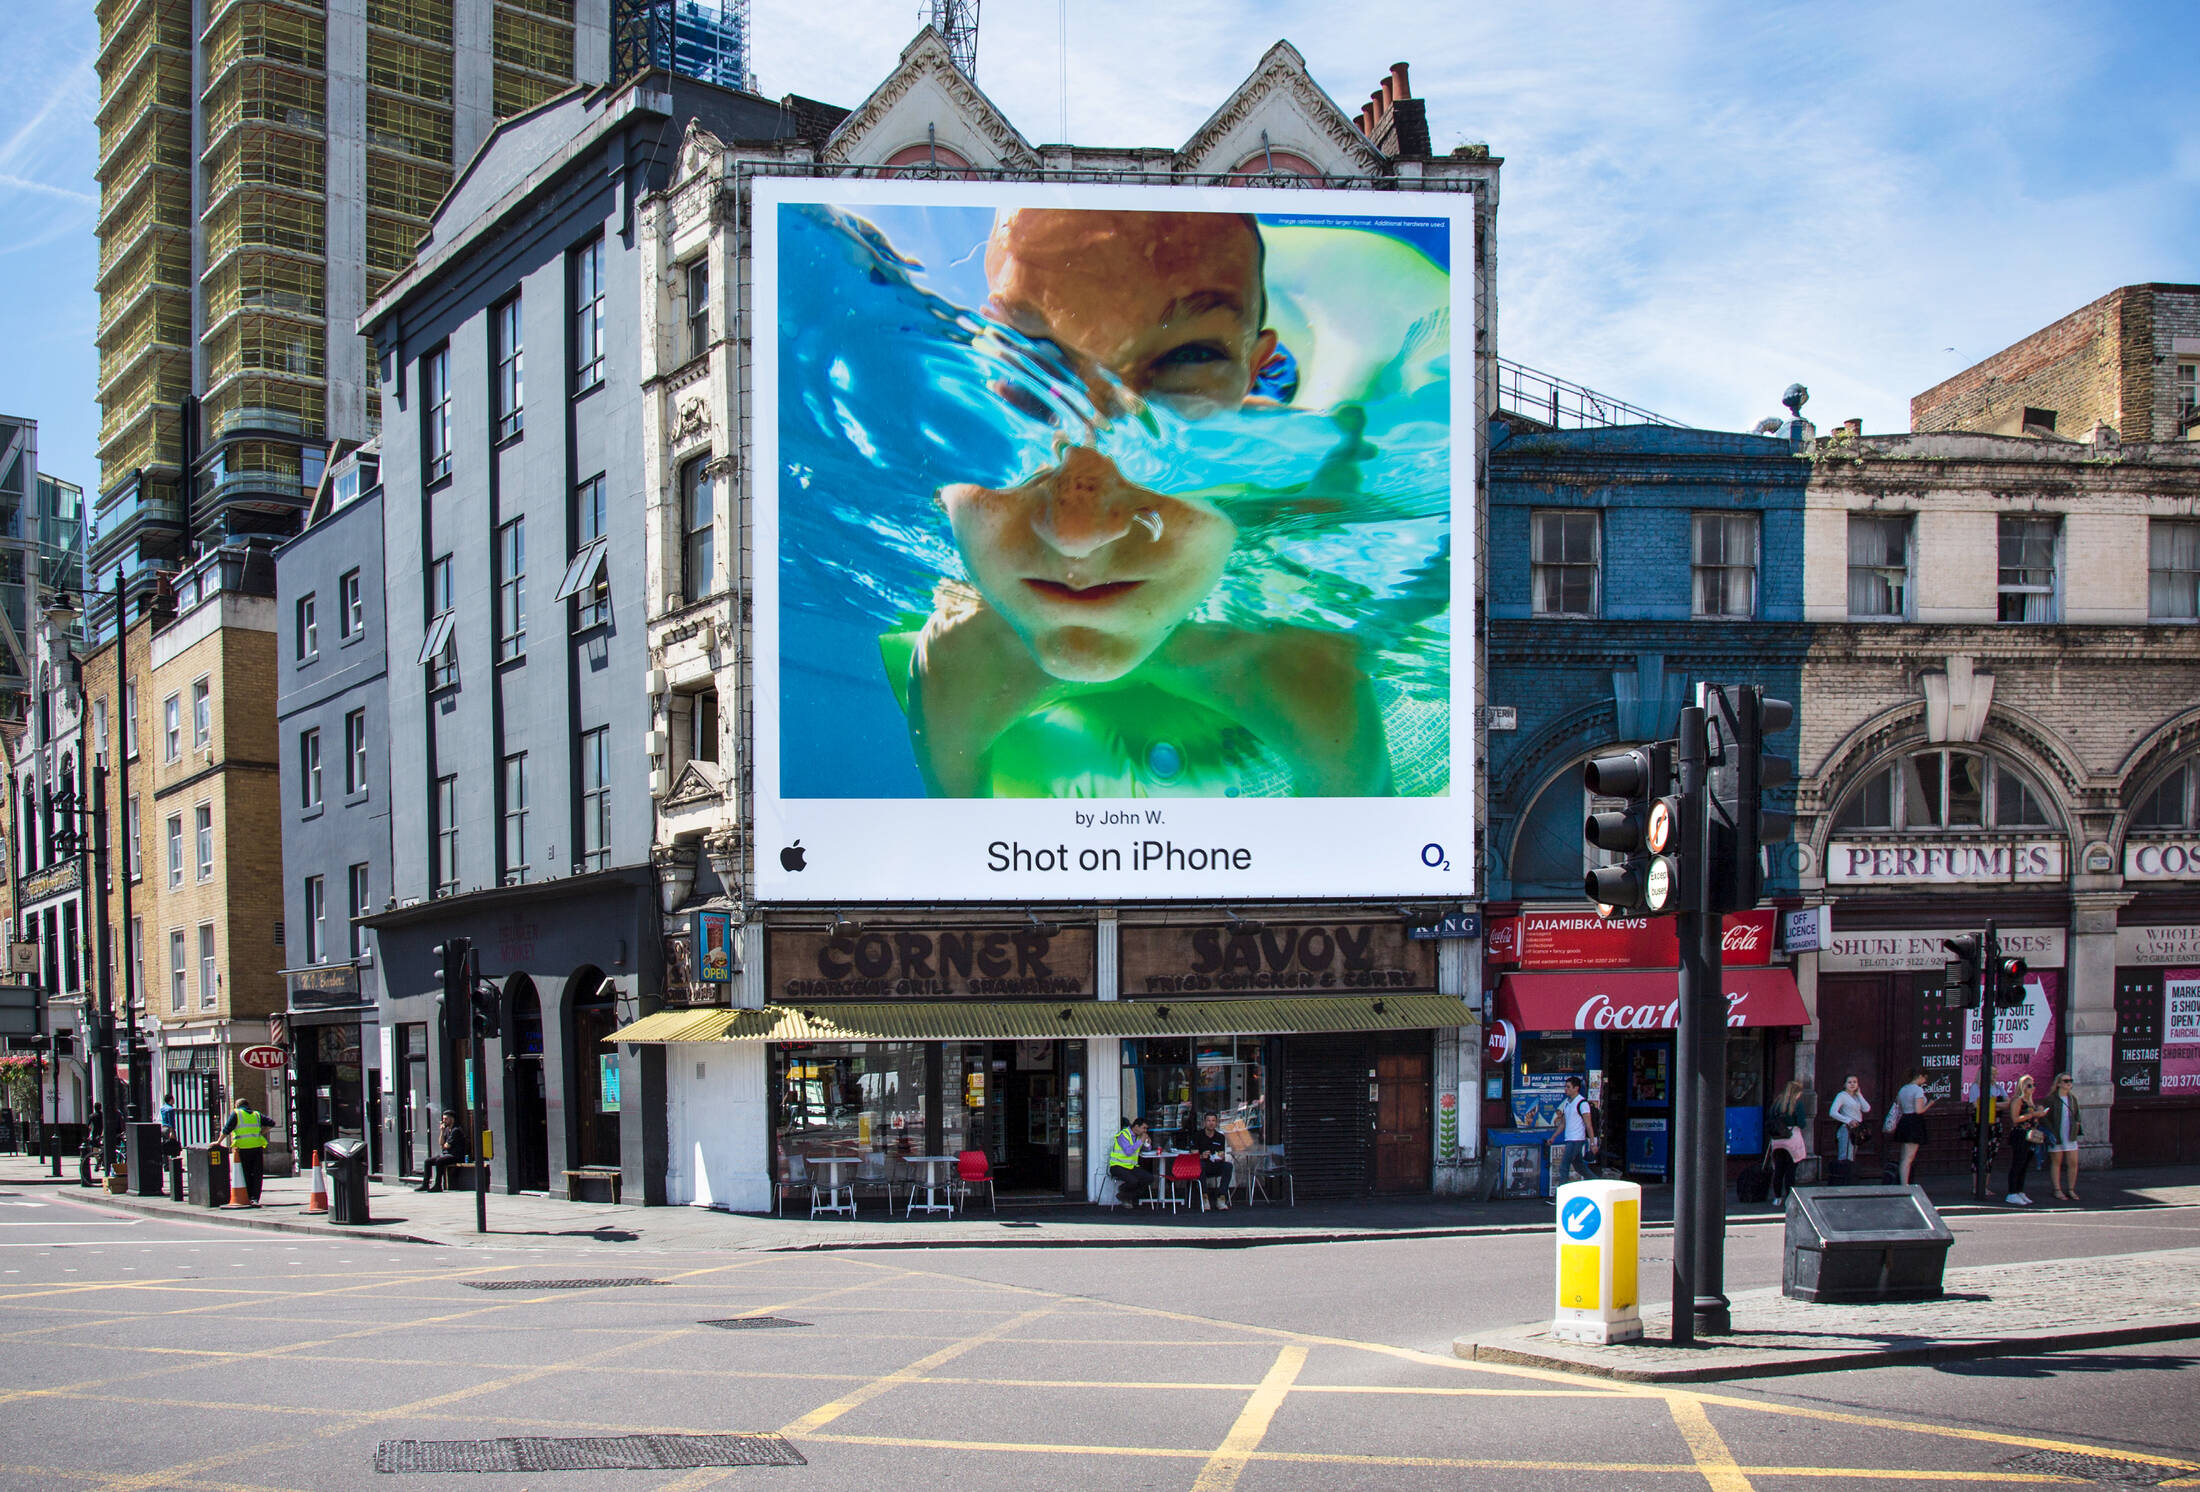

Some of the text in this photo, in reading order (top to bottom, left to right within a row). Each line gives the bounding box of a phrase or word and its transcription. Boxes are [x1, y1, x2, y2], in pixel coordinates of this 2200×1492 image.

[1075, 810, 1166, 828] by John W.
[988, 841, 1252, 872] Shot on iPhone
[1846, 846, 2049, 876] PERFUMES
[1527, 918, 1648, 931] JAIAMIBKA NEWS
[1792, 913, 1808, 925] OFF
[1785, 923, 1817, 938] LICENCE
[1190, 926, 1373, 973] SAVOY
[2178, 943, 2188, 953] &
[818, 932, 1053, 979] CORNER
[2149, 954, 2175, 963] GREAT
[1889, 959, 1904, 967] 247
[703, 967, 728, 980] OPEN
[2123, 984, 2153, 992] THE
[2009, 1004, 2035, 1017] SUITE
[2171, 1001, 2178, 1013] &
[1998, 1019, 2004, 1031] 7
[2005, 1018, 2029, 1031] DAYS
[2170, 1014, 2192, 1027] OPEN
[1488, 1033, 1507, 1048] ATM
[248, 1051, 284, 1065] ATM
[1921, 1055, 1961, 1067] THESTAGE
[2121, 1048, 2160, 1061] THESTAGE
[1921, 1080, 1951, 1093] Galliard
[2119, 1074, 2150, 1087] Galliard
[2161, 1074, 2178, 1088] 020
[289, 1086, 300, 1173] BARBERS
